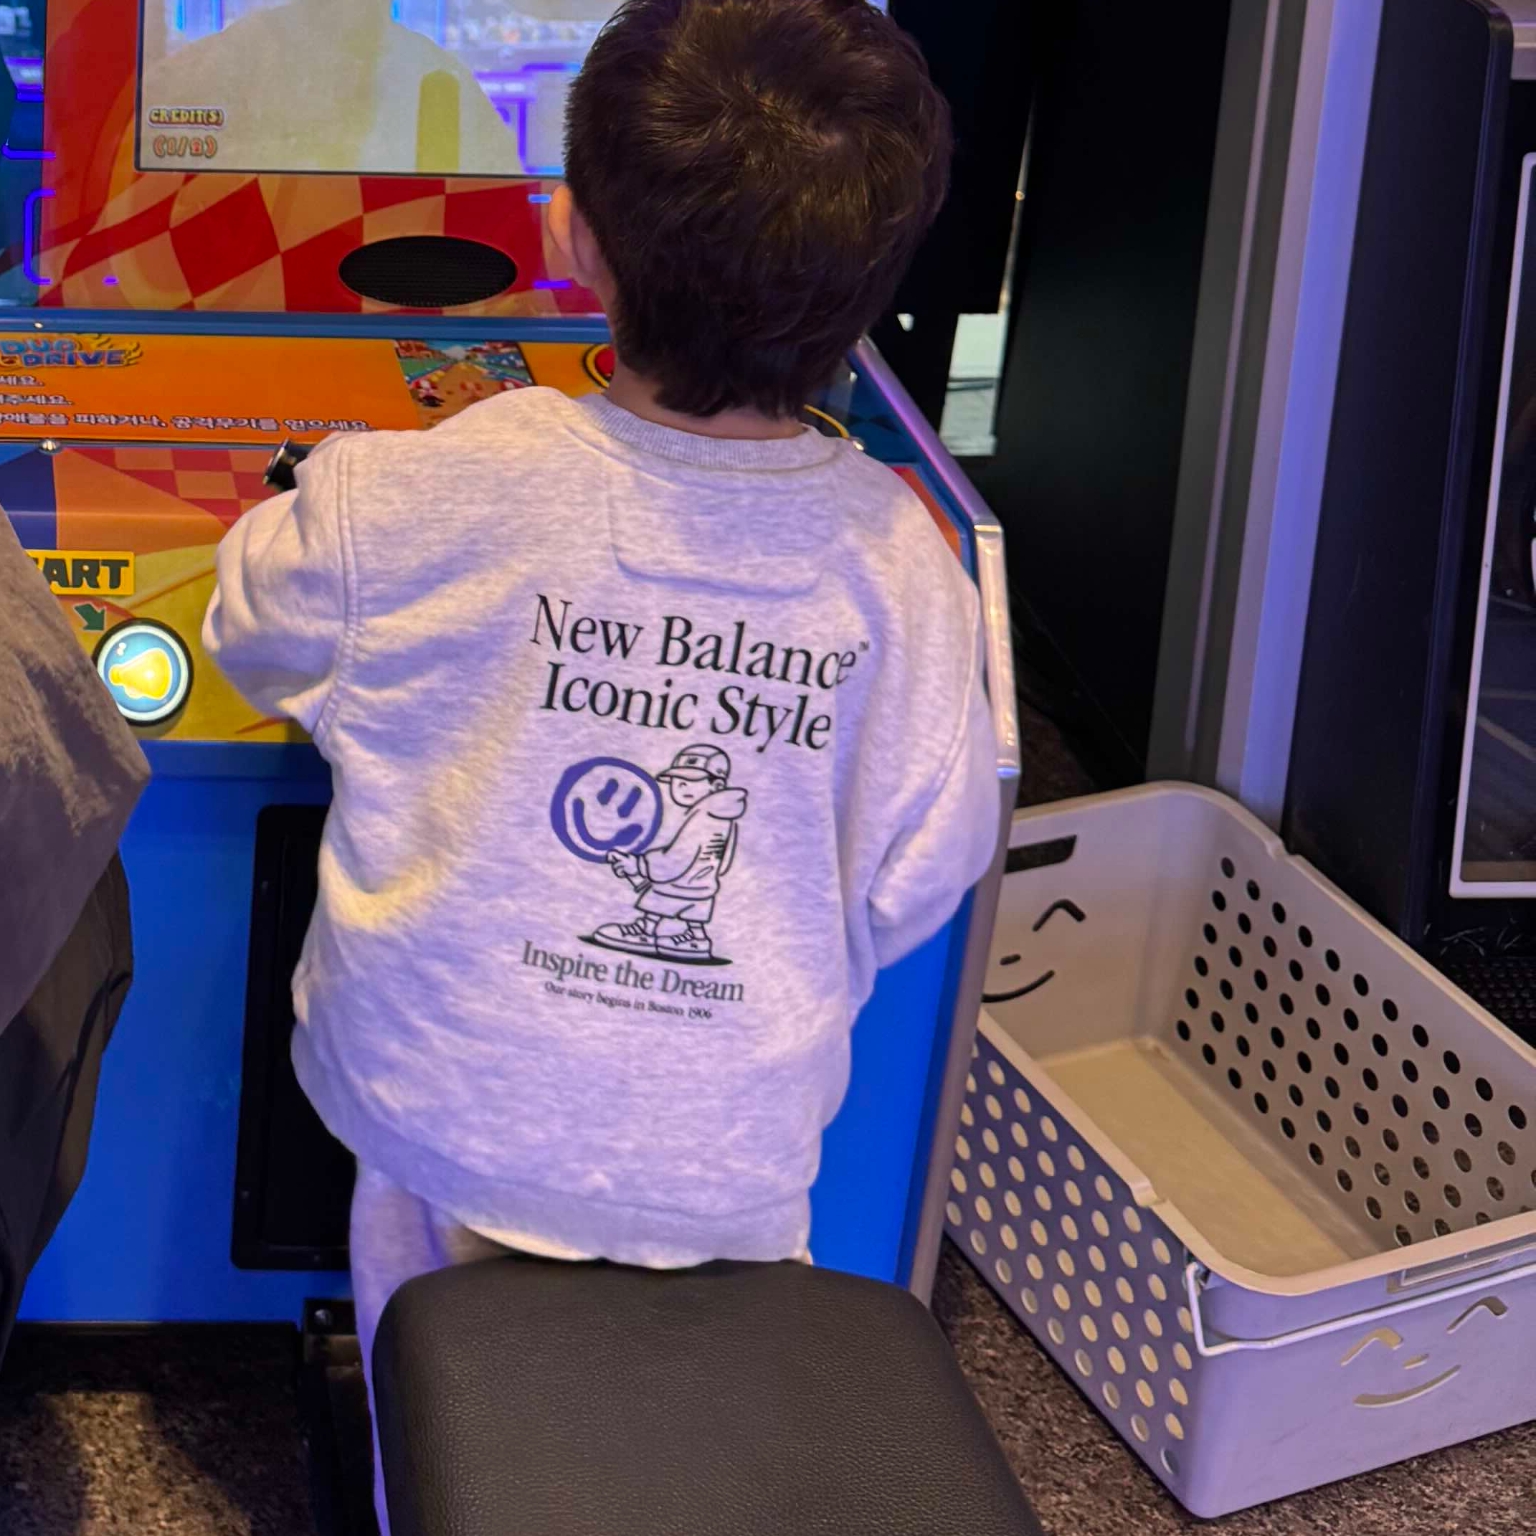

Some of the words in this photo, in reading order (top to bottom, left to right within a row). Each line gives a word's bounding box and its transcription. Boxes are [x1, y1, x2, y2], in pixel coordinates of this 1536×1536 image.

[149, 108, 224, 126] CREDIT(S)
[22, 350, 128, 368] DRIVE
[74, 413, 167, 429] 피하거나,
[35, 557, 130, 590] ART
[530, 593, 644, 659] New
[656, 616, 857, 689] Balance
[539, 661, 698, 730] Iconic
[710, 685, 832, 753] Style
[522, 940, 608, 982] Inspire
[614, 960, 654, 991] the
[660, 968, 745, 1002] Dream
[544, 981, 566, 996] Our
[567, 988, 594, 1004] story
[596, 993, 631, 1009] begins
[633, 998, 646, 1010] in
[647, 1001, 685, 1017] Boston
